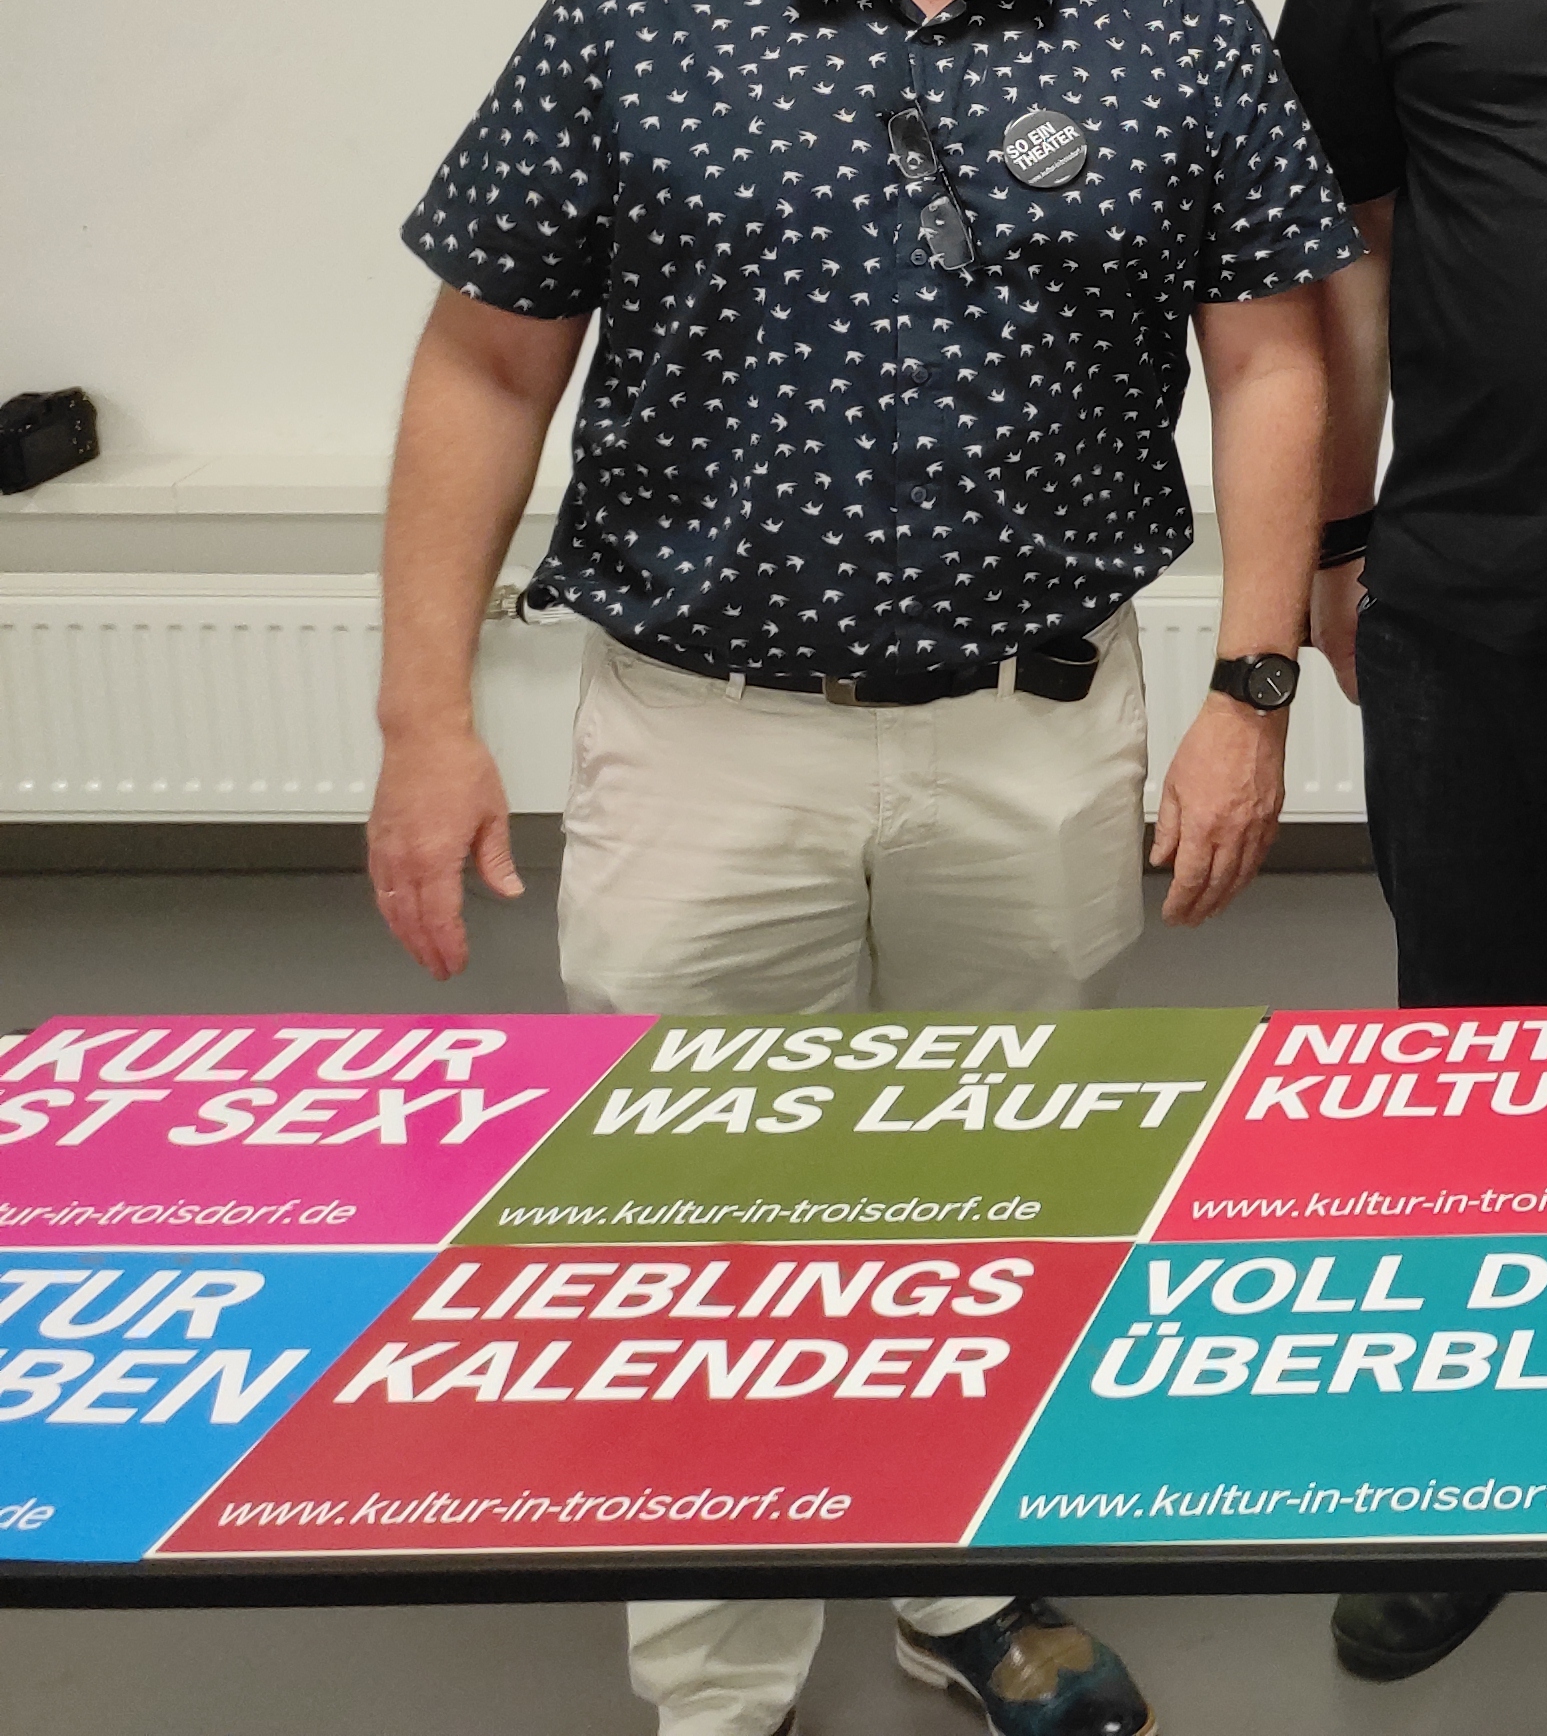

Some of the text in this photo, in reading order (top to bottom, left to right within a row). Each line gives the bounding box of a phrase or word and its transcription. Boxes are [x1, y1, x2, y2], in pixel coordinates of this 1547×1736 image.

[1006, 121, 1056, 159] SO EIN
[1013, 125, 1080, 171] THEATER
[0, 1028, 506, 1082] KULTUR
[651, 1025, 1056, 1072] WISSEN
[0, 1088, 548, 1146] ST SEXY
[593, 1073, 1206, 1134] WAS LÄUFT
[499, 1197, 1041, 1225] www.kultur-in-troisdorf.de
[412, 1258, 1034, 1320] LIEBLINGS
[1149, 1255, 1424, 1315] VOLL
[0, 1349, 309, 1424] BEN
[334, 1337, 1010, 1403] KALENDER
[219, 1488, 851, 1526] www.kultur-in-troisdorf.de
